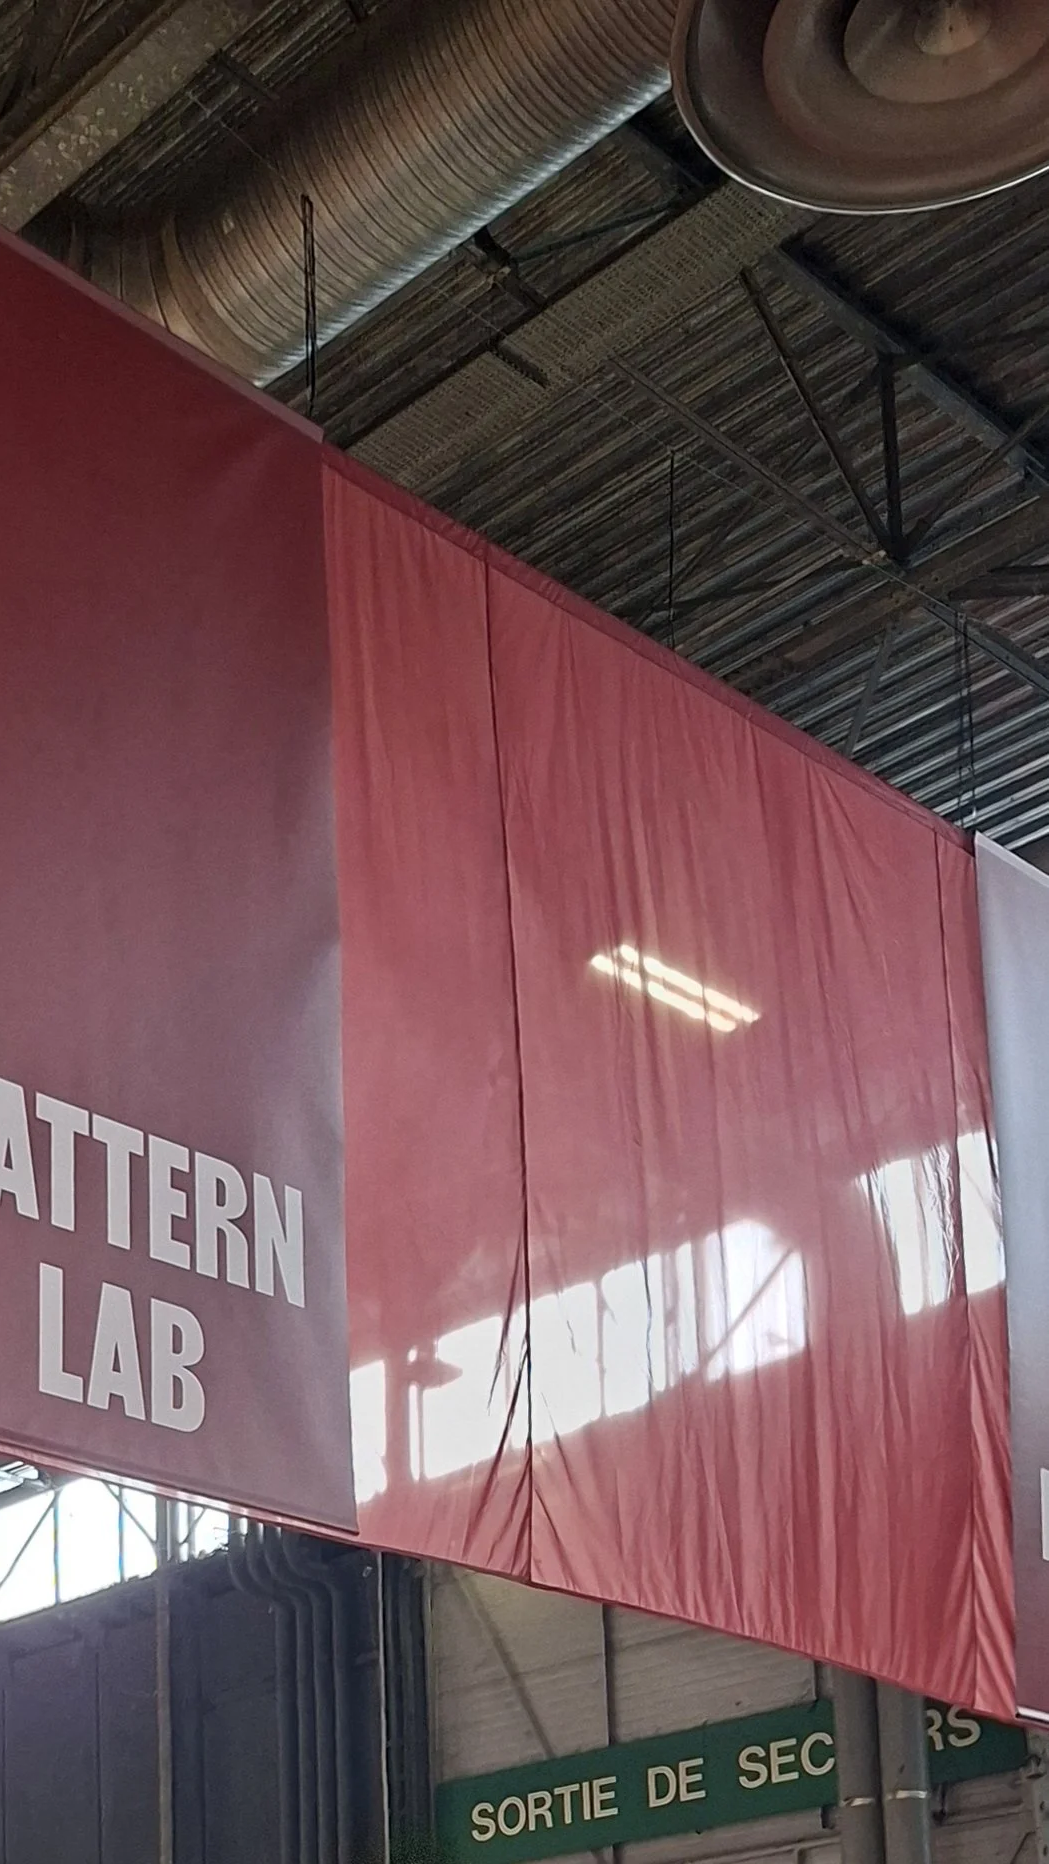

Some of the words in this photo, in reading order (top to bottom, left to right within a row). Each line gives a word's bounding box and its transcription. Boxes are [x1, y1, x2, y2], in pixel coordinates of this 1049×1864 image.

[38, 1261, 205, 1433] LAB
[470, 1775, 620, 1842] SORTIE
[647, 1757, 707, 1809] DE
[738, 1704, 982, 1789] SECRS
